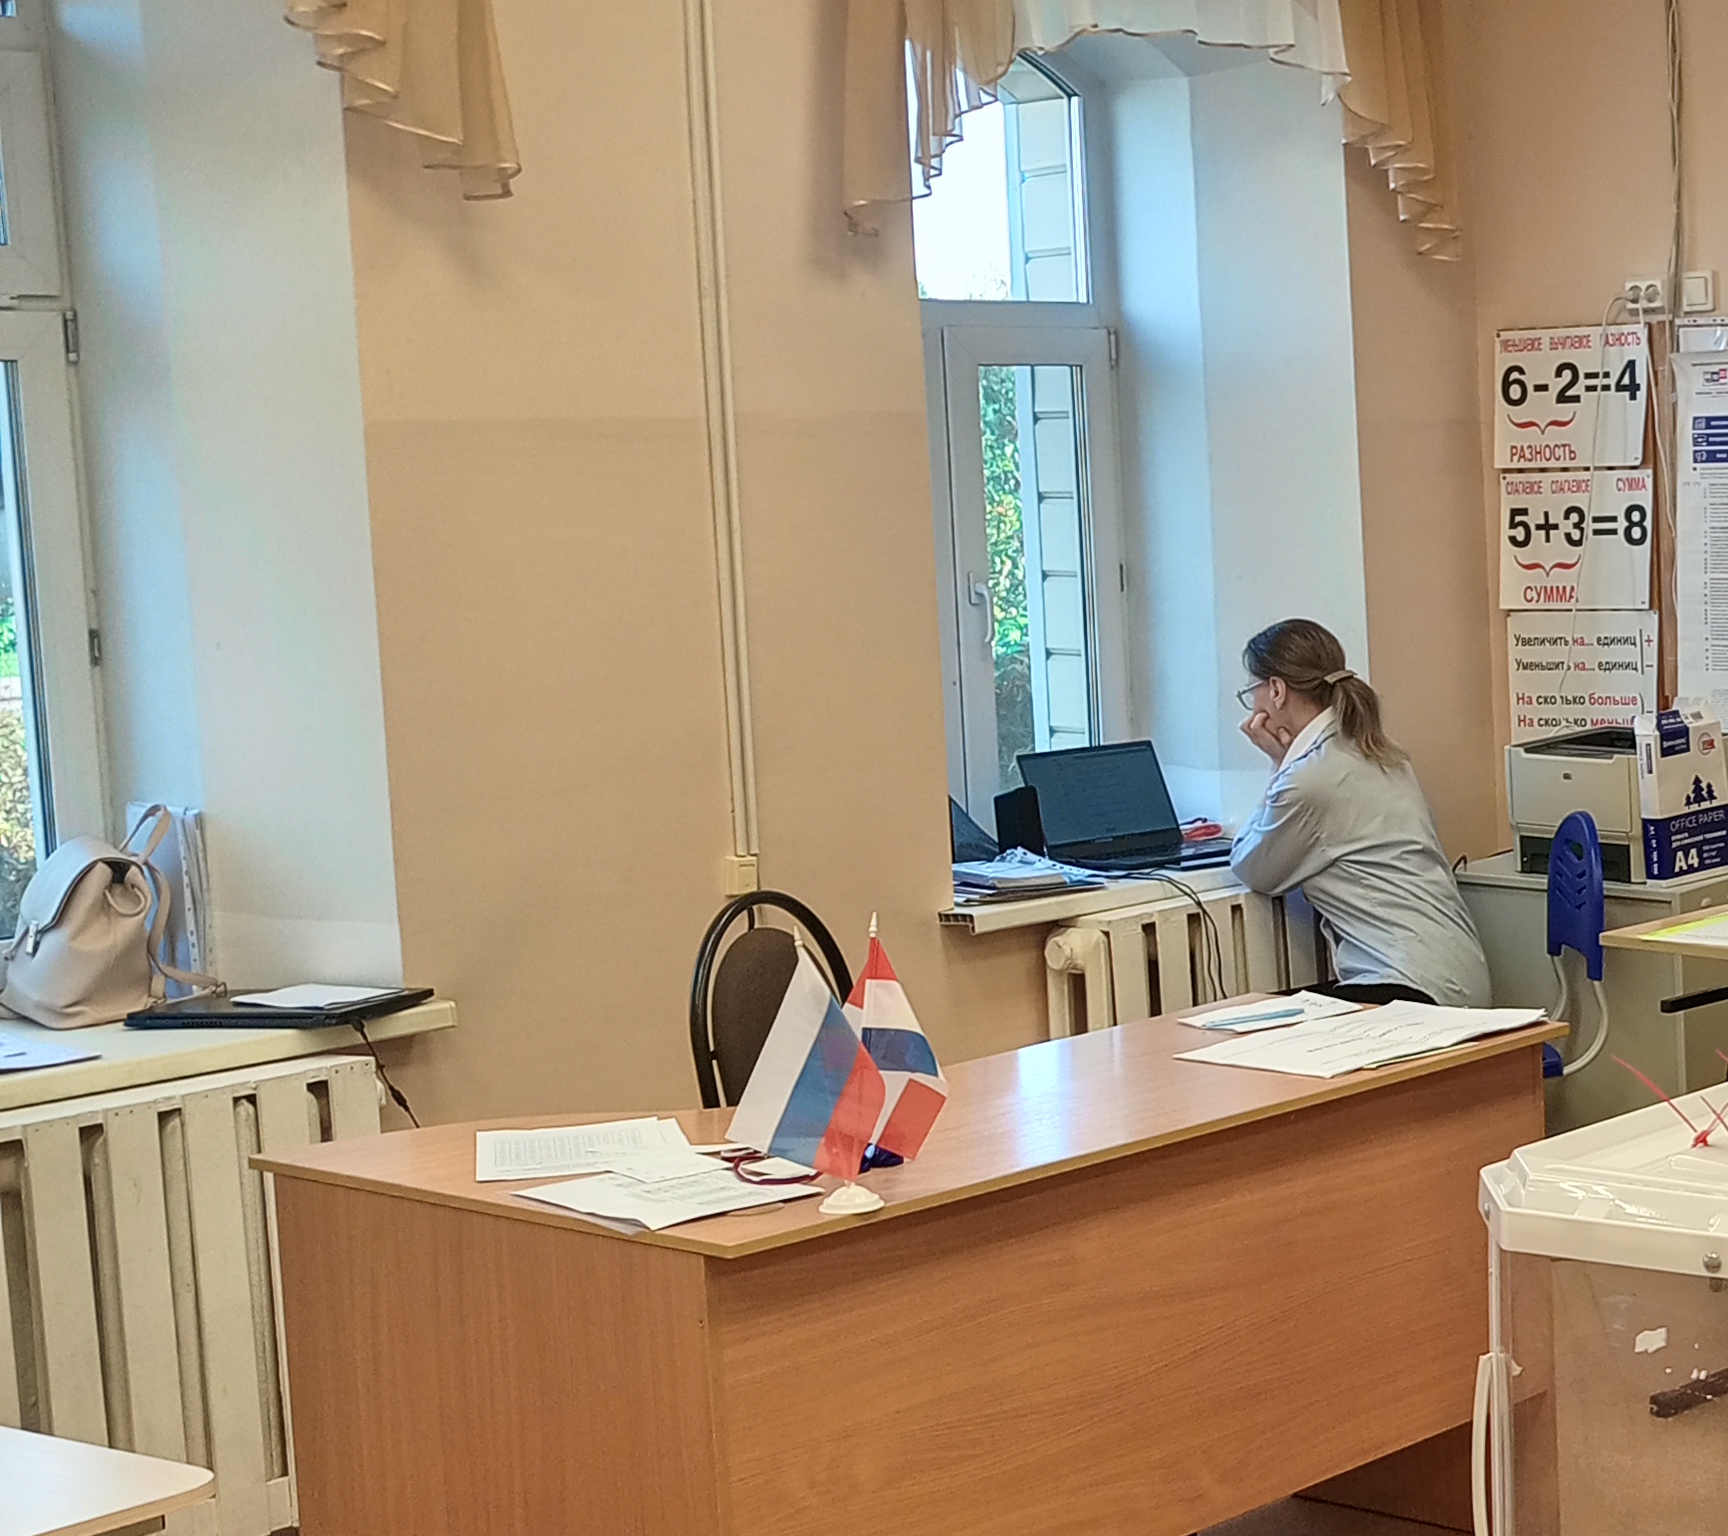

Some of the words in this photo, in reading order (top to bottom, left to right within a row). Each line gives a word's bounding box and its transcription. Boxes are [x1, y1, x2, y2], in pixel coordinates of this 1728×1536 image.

[1510, 444, 1577, 463] РАЗНОСТЬ
[1616, 477, 1648, 492] СУММА
[1523, 585, 1579, 604] СУММА
[1514, 634, 1569, 647] Увеличить
[1596, 635, 1637, 648] единиц
[1515, 658, 1571, 671] Уменьшить
[1598, 660, 1638, 673] единиц
[1516, 692, 1533, 705] На
[1588, 692, 1638, 706] больше
[1517, 715, 1534, 728] На
[1591, 717, 1635, 727] меньш
[1669, 815, 1697, 832] OFFICE
[1699, 810, 1725, 824] PAPER
[1674, 848, 1699, 873] A4
